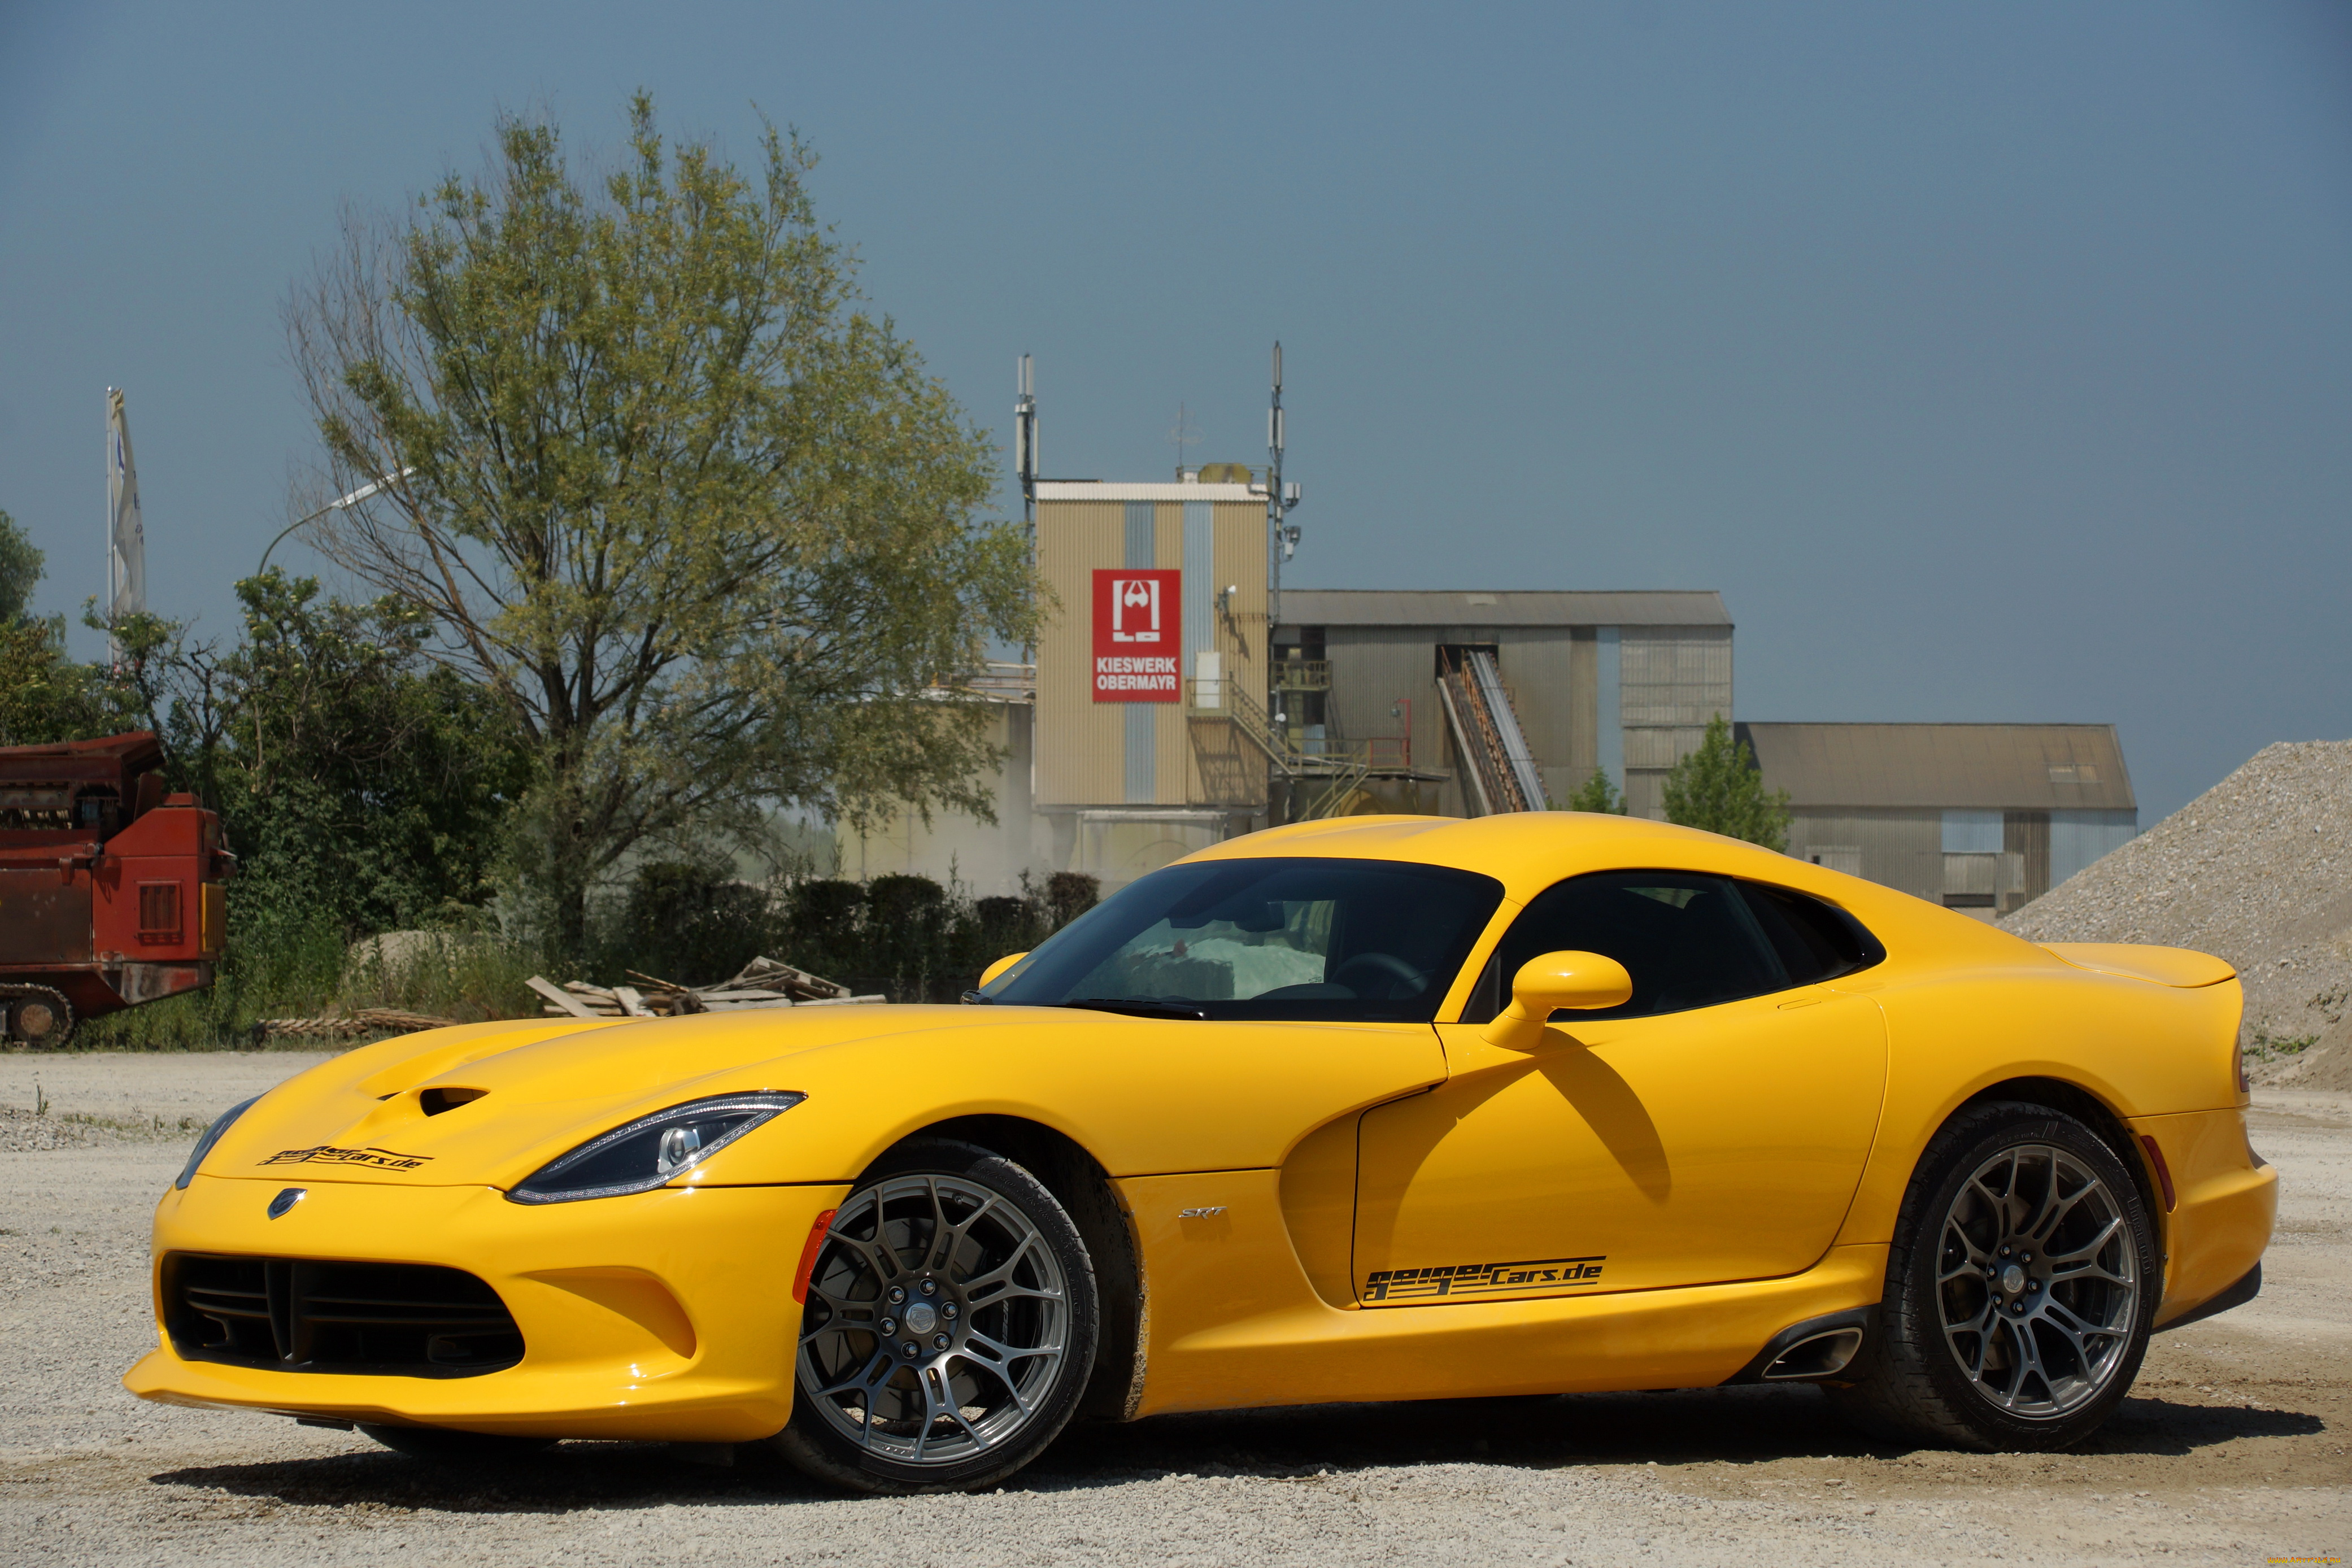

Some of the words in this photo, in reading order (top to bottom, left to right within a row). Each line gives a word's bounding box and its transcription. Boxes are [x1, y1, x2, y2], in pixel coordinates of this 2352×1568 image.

[1097, 657, 1176, 673] KIESWERK
[1097, 675, 1176, 690] OBERMAYR
[1178, 1206, 1227, 1219] SRT
